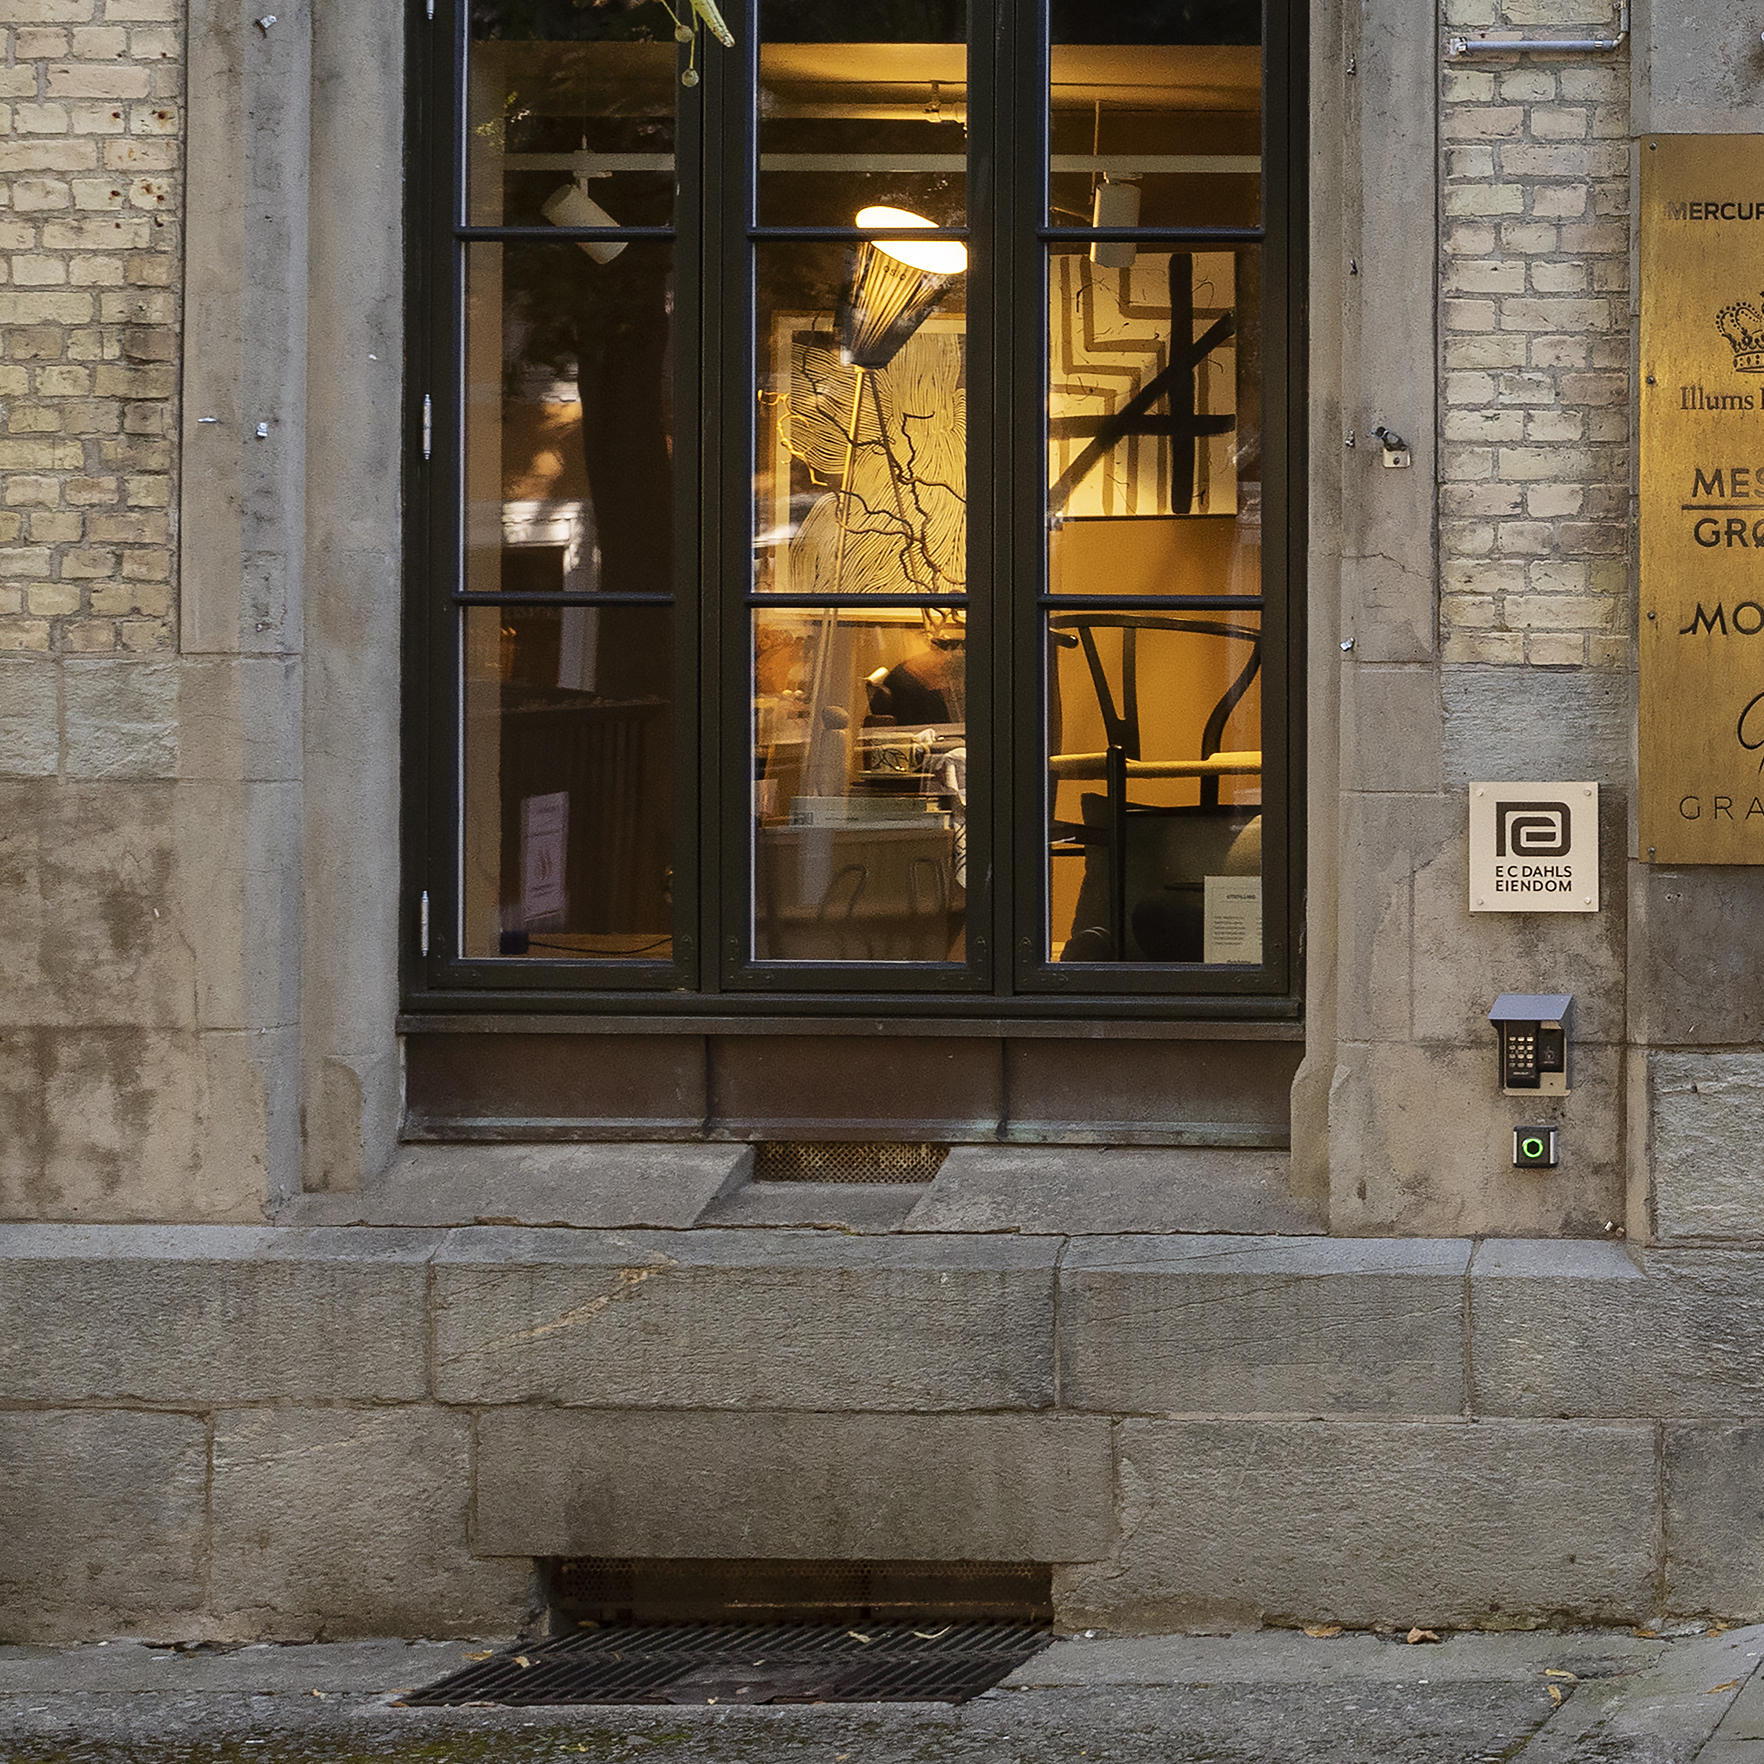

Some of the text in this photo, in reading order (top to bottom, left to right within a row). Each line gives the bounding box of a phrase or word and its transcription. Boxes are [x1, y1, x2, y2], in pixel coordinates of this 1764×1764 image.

[1680, 387, 1754, 411] Illums
[1495, 865, 1573, 878] E C DAHLS
[1495, 880, 1572, 892] EIENDOM
